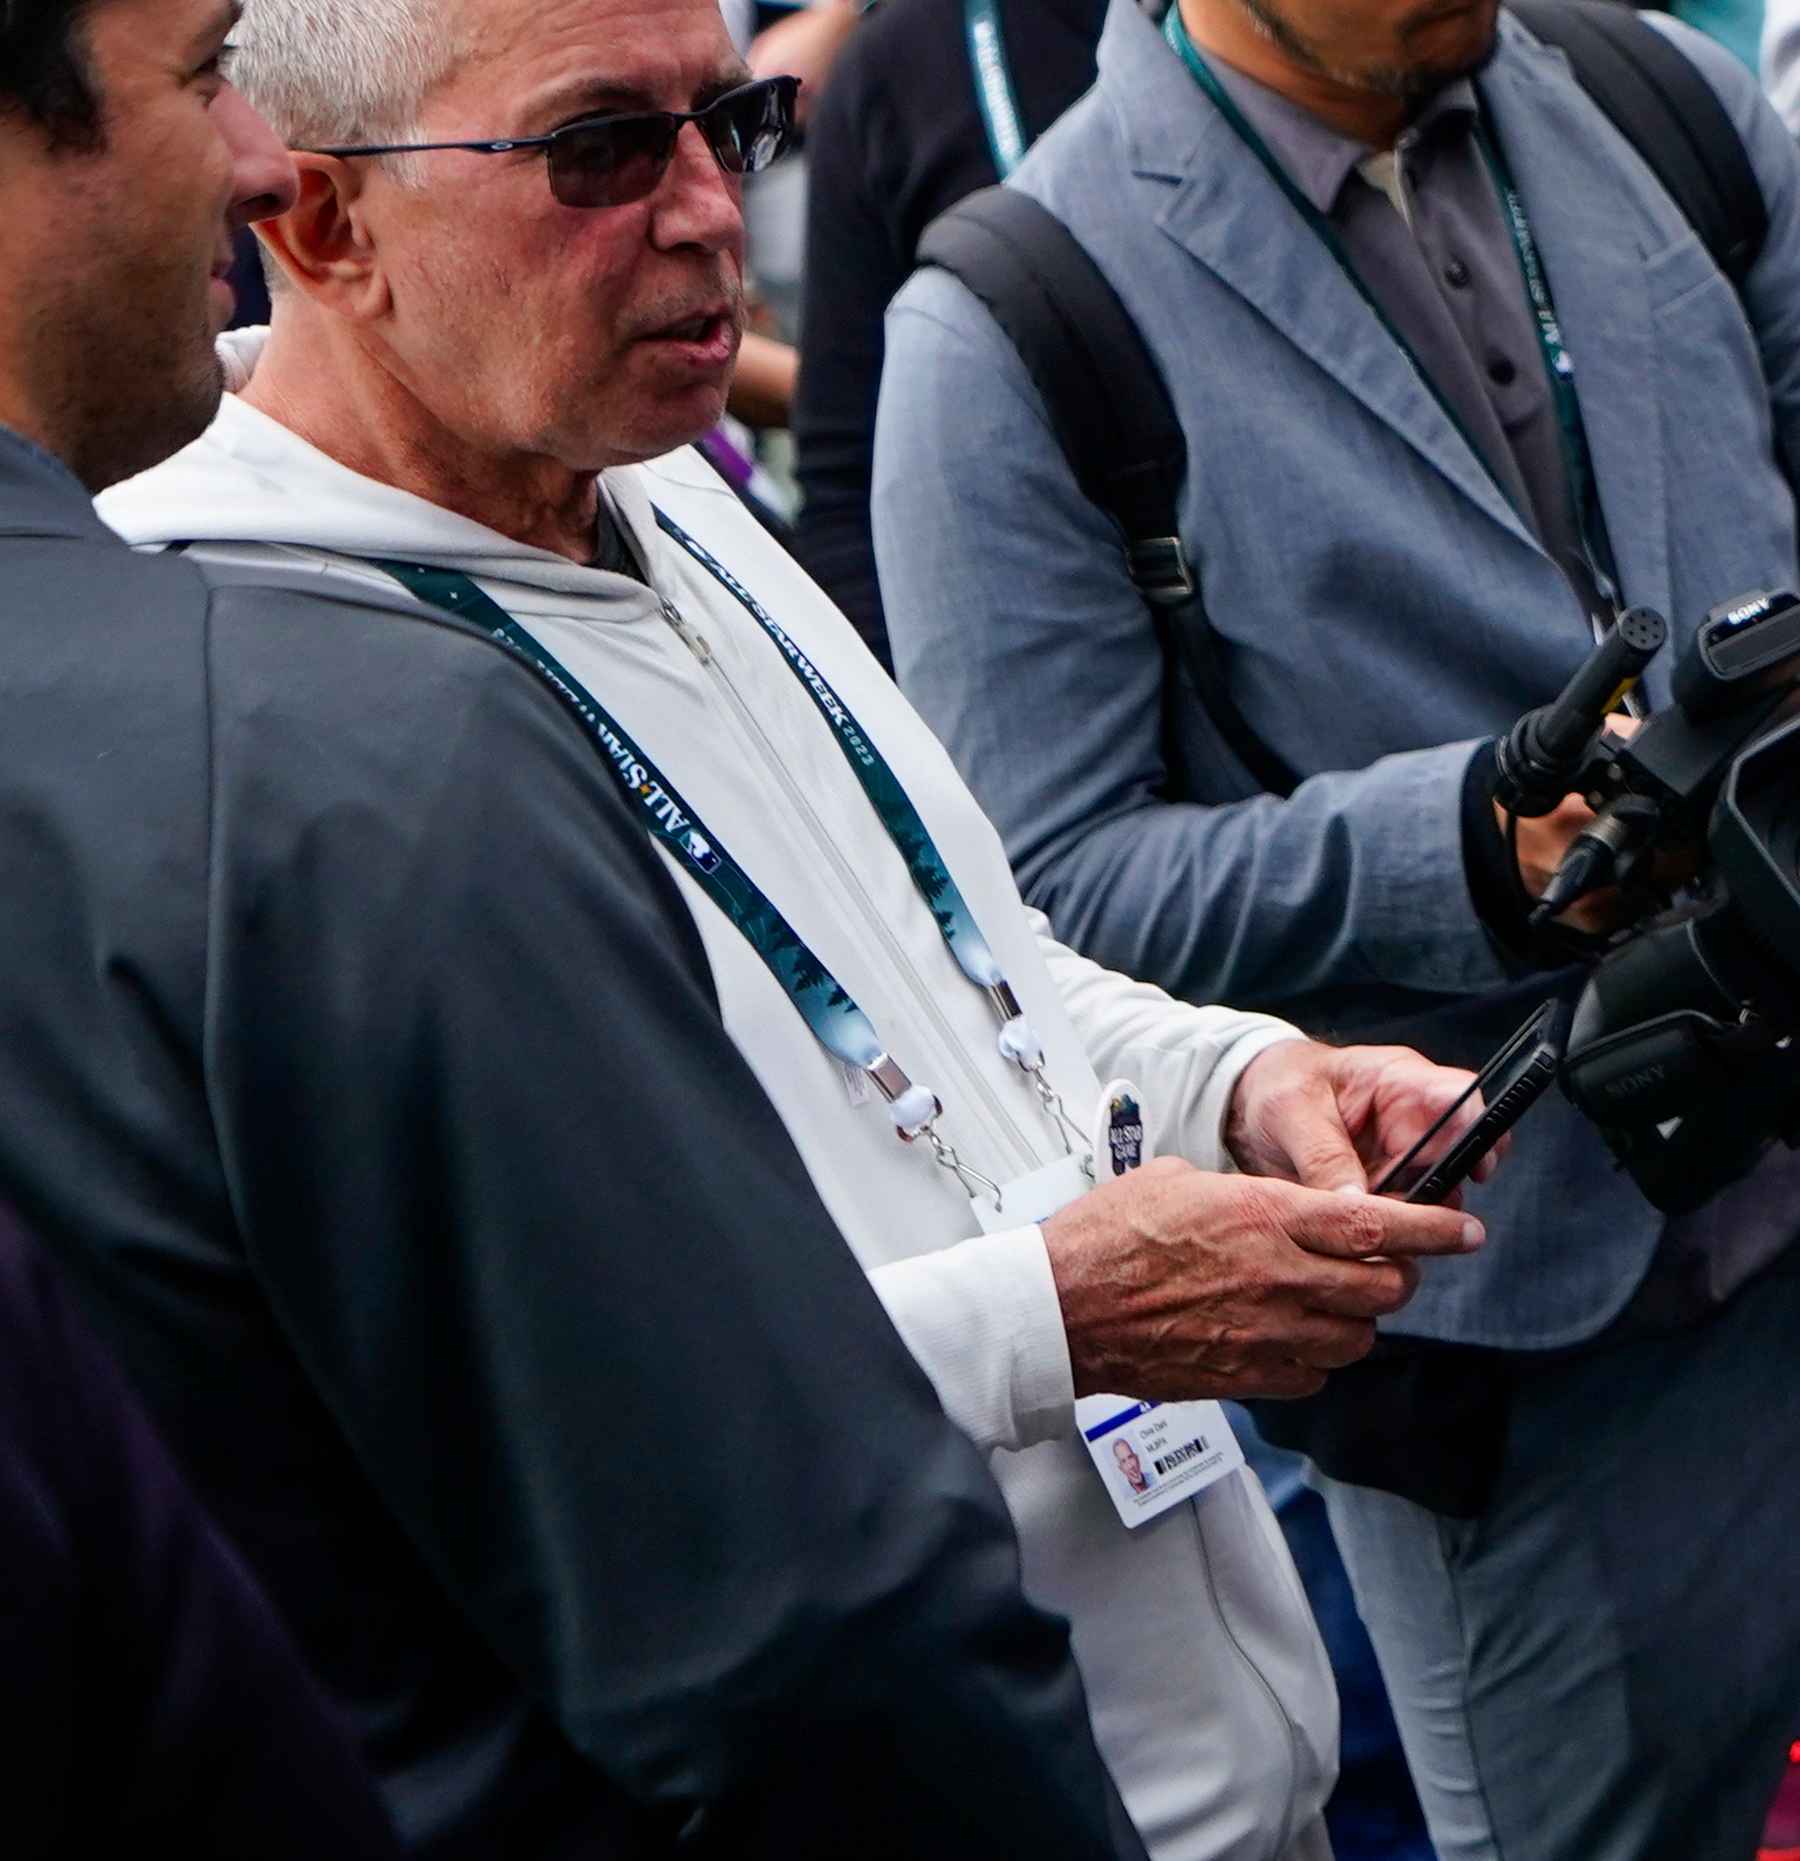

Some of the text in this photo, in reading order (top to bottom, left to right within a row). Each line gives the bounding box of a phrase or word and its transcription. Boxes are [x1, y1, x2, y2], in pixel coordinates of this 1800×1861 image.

[1727, 596, 1770, 626] SONY
[796, 651, 851, 729] WEEK
[842, 725, 876, 768] 2023
[643, 780, 693, 834] ALL
[1604, 1062, 1666, 1096] SONY
